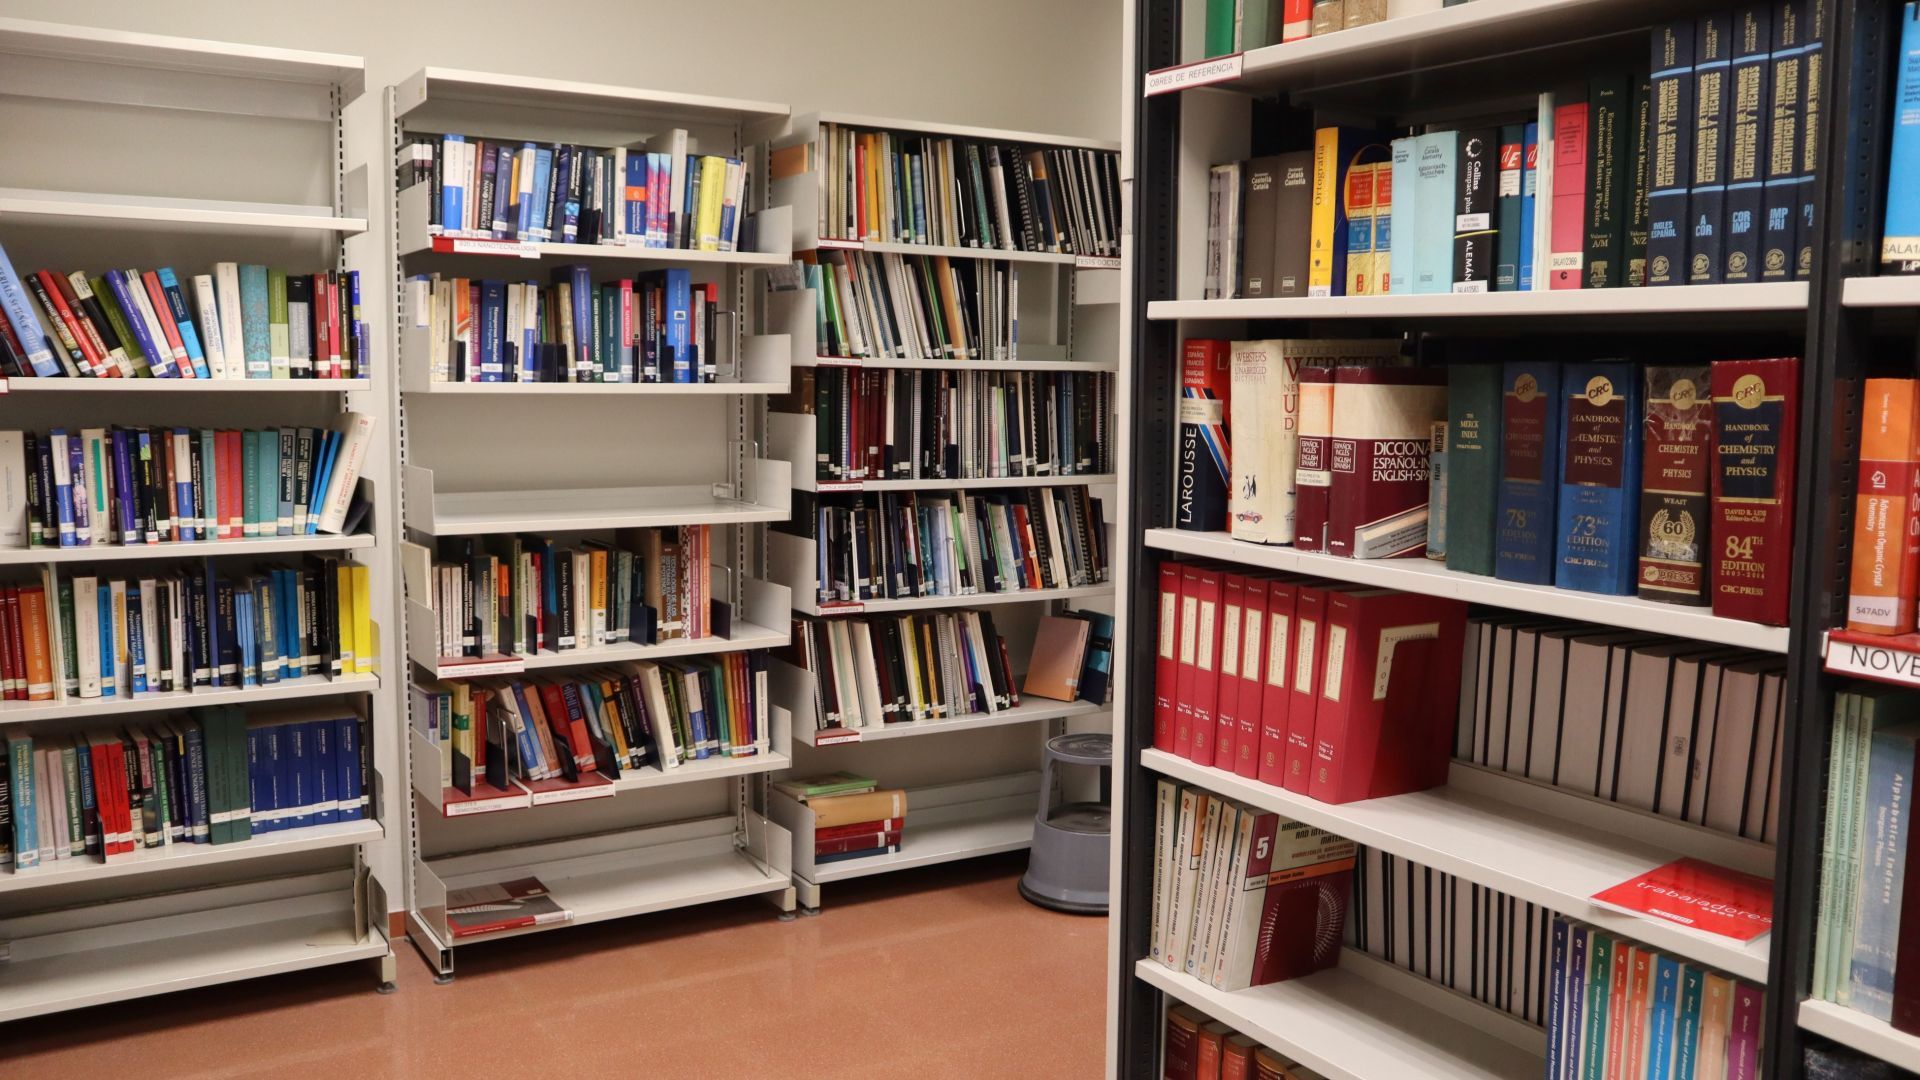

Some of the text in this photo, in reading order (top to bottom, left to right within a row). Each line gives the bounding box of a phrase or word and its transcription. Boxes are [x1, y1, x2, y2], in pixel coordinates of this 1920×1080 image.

[1149, 77, 1173, 88] OBRES
[1175, 72, 1185, 82] DE
[1785, 59, 1798, 105] TECNICOS
[1709, 72, 1721, 116] TECNICOS
[1747, 66, 1760, 111] TECNICOS
[1668, 79, 1679, 121] TECNICOS
[1772, 61, 1786, 174] DICCIONARIO DE TERMINOS
[1805, 54, 1819, 171] DICCIONARIO DE TERMINOS
[1697, 74, 1709, 183] DICCIONARIO DE TERMINOS
[1734, 68, 1748, 179] DICCIONARIO DE TERMINOS
[1656, 81, 1669, 186] DICCIONARIO DE TERMINOS
[1744, 123, 1756, 178] CIENTIFICOS
[1782, 117, 1794, 174] CIENTIFICOS
[1634, 100, 1648, 224] Condensed Matter Physics
[1666, 133, 1677, 185] CIENTIFICOS
[1706, 128, 1717, 181] CIENTIFICOS
[1594, 106, 1605, 227] Condensed Matter Physics
[1603, 112, 1614, 221] Encyclopedic Dictionary of
[1473, 161, 1481, 190] Collins
[1732, 210, 1750, 222] COR
[1770, 208, 1788, 219] IMP
[1696, 225, 1712, 236] COR
[1732, 222, 1750, 233] IMP
[1769, 218, 1784, 231] PRI
[1465, 241, 1473, 281] ALEMÁN
[1516, 380, 1535, 397] CRC
[1588, 382, 1609, 399] CRC
[1673, 387, 1694, 401] CRC
[1735, 383, 1761, 401] CRC
[1460, 420, 1478, 428] MERCK
[1572, 415, 1621, 424] HANDBOOK
[1461, 430, 1478, 438] INDEX
[1725, 424, 1770, 432] HANDBOOK
[1744, 434, 1753, 443] of
[1659, 444, 1699, 455] CHEMISTRY
[1718, 444, 1775, 455] CHEMISTRY
[1574, 456, 1613, 466] PHYSICS
[1741, 457, 1755, 465] and
[1181, 427, 1197, 523] LAROUSSE
[1663, 468, 1692, 479] PHYSICS
[1726, 467, 1767, 478] PHYSICS
[1725, 508, 1746, 516] DAVID
[1866, 498, 1877, 531] Chemistry
[1878, 499, 1888, 529] Advances
[1664, 521, 1683, 535] 60
[1567, 536, 1609, 548] EDITION
[1874, 538, 1886, 562] Organic
[1721, 560, 1765, 572] EDITION
[1873, 564, 1883, 586] Crystal
[1720, 585, 1763, 596] CRC PRESS
[1855, 606, 1891, 617] 547ADV
[1877, 806, 1887, 840] Inorganic
[1883, 773, 1903, 904] Alphabetical Indexes
[1256, 836, 1270, 860] 5
[1636, 882, 1772, 924] trabajadores
[1557, 931, 1562, 940] 1
[1577, 938, 1582, 947] 2
[1599, 947, 1604, 956] 3
[1618, 955, 1624, 963] 4
[1638, 961, 1644, 970] 5
[1663, 969, 1669, 977] 6
[1689, 978, 1695, 987] 7
[1743, 997, 1751, 1007] 9
